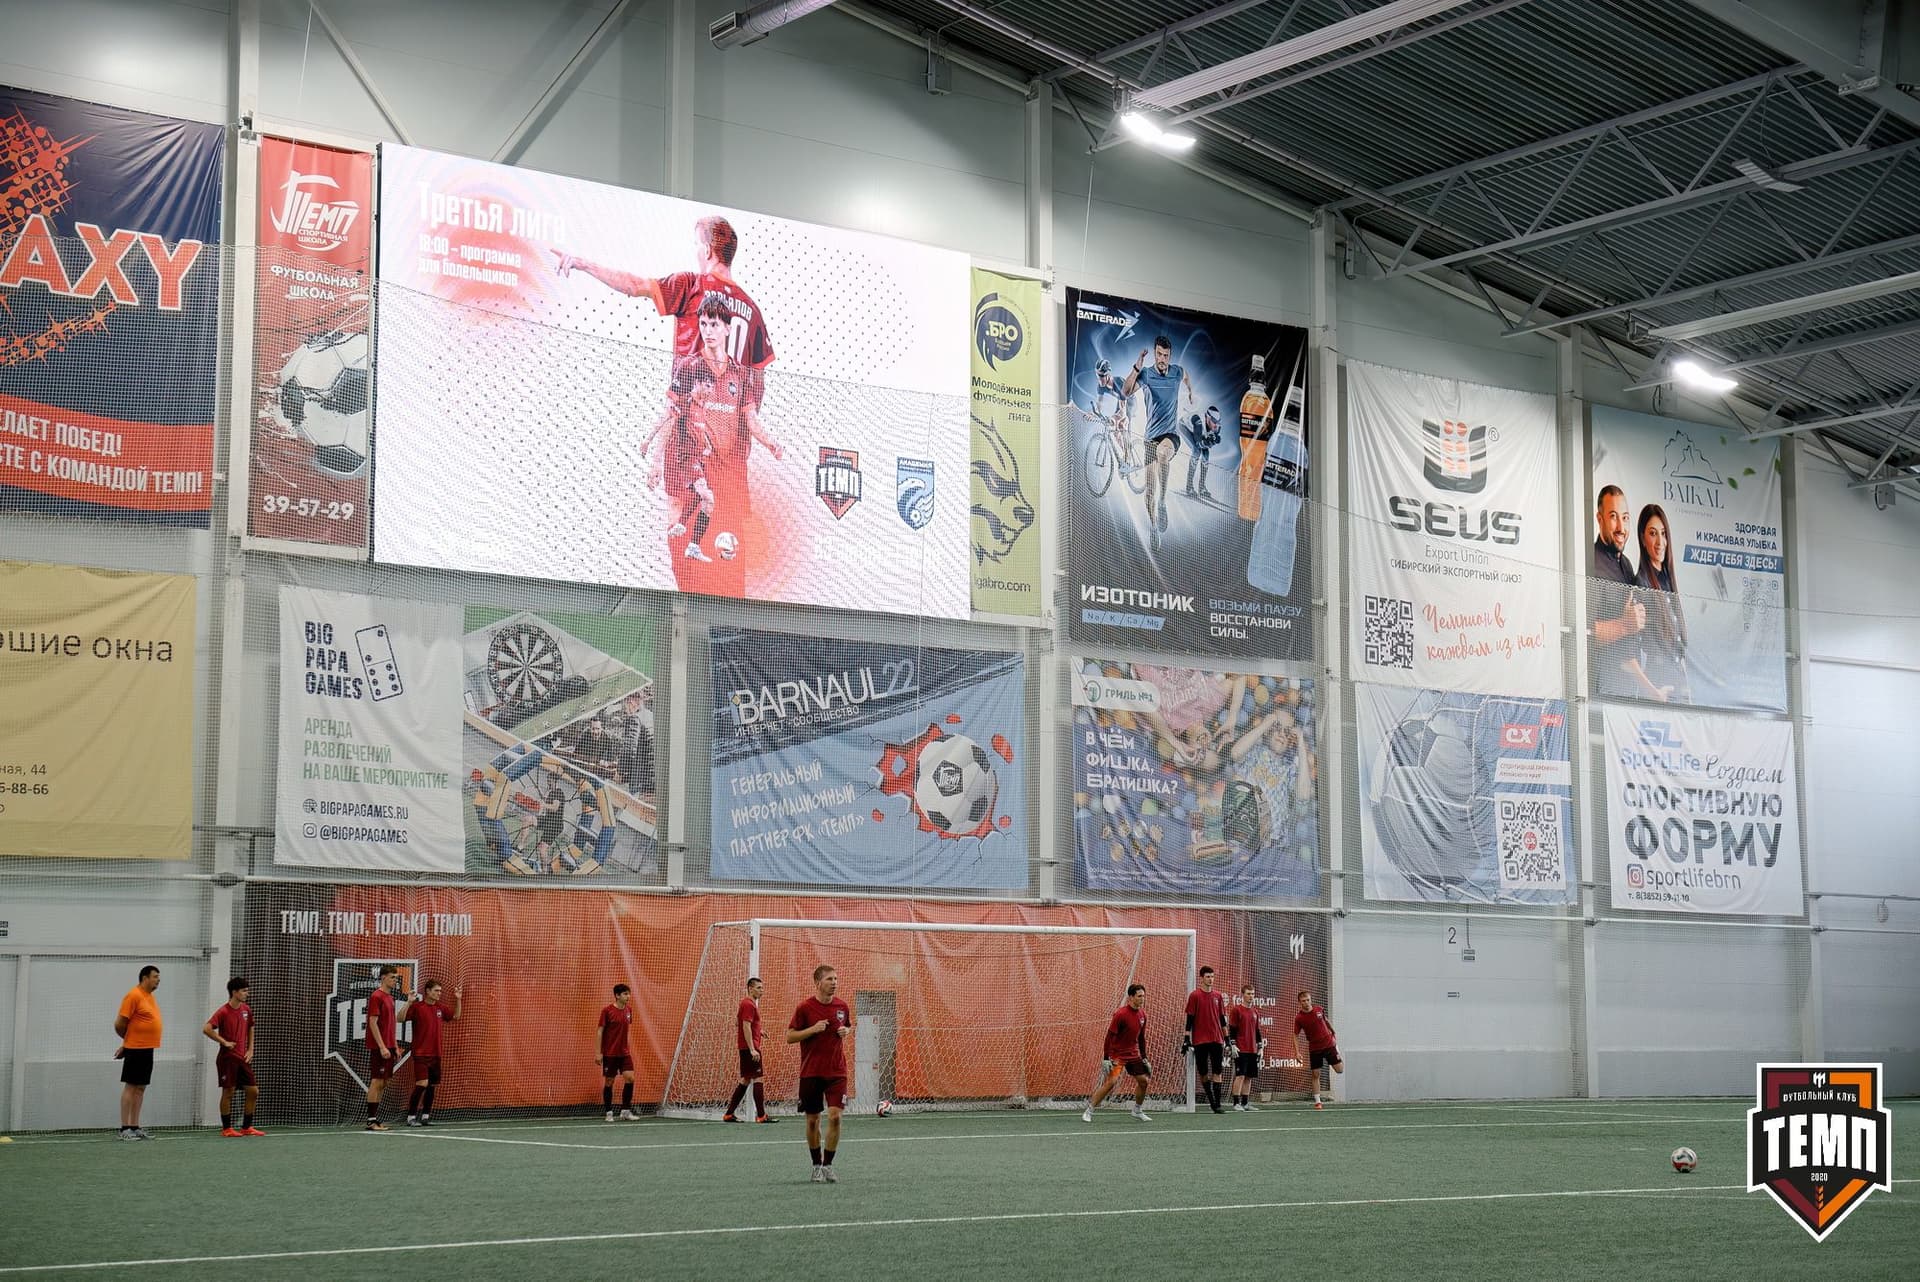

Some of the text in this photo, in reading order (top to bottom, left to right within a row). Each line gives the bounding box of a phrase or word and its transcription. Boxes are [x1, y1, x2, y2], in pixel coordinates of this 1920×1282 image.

[270, 170, 360, 235] ТЕМП
[417, 180, 503, 234] Третья
[460, 244, 521, 268] программа
[271, 265, 358, 288] ФУТБОЛЬНАЯ
[443, 258, 518, 287] болельщиков
[289, 285, 335, 301] ШКОЛА
[1077, 310, 1131, 327] BATTERADE
[972, 376, 1031, 397] Молодёжная
[973, 391, 1031, 409] футбольная
[1008, 412, 1031, 423] лига
[0, 409, 122, 457] ЛАЕТ ПОБЕД!
[0, 443, 202, 493] ТЕ С КОМАНДОЙ ТЕМП!
[819, 467, 859, 498] ТЕМП
[1663, 481, 1725, 509] BAIKAL
[263, 495, 354, 520] 39-57-29
[1389, 496, 1522, 545] SEUS
[1735, 522, 1777, 537] ЗДОРОВАЯ
[1696, 531, 1777, 551] И КРАСИВАЯ УЛЫБКА
[1425, 545, 1489, 566] Export Union
[1690, 548, 1777, 570] ЖДЕТ ТЕБЯ ЗДЕСЬ!
[1391, 558, 1441, 576] СИБИРСКИЙ
[1443, 566, 1499, 581] ЭКСПОРТНЫЙ
[1081, 584, 1195, 613] ИЗОТОНИК
[1209, 599, 1261, 614] ВОЗЬМИ
[1210, 613, 1291, 629] ВОССТАНОВИ
[1423, 603, 1492, 633] Чемпион
[304, 621, 333, 645] BIG
[1210, 627, 1249, 639] СИЛЫ.
[1496, 637, 1512, 660] из
[1517, 623, 1545, 650] нас!
[0, 630, 173, 662] шие окна
[305, 646, 349, 673] PAPA
[305, 671, 363, 700] GAMES
[1105, 689, 1136, 701] ГРИЛЬ
[304, 717, 352, 739] АРЕНДА
[1085, 727, 1135, 749] В ЧЁМ
[304, 739, 392, 763] РАЗВЛЕЧЕНИЙ
[1621, 748, 1700, 772] SportLife
[31, 764, 47, 775] 44
[1086, 752, 1154, 775] ФИШКА,
[1705, 754, 1786, 788] Создаем
[303, 763, 449, 789] НА ВАШЕ МЕРОПРИЯТИЕ
[730, 759, 823, 796] ГЕНЕРАЛЬНЫЙ
[1087, 773, 1178, 794] БРАТИШКА?
[320, 801, 409, 820] BIGPAPAGAMES.RU
[731, 783, 856, 828] ИНФОРМАЦИОННЫЙ
[1623, 782, 1782, 818] СПОРТИВНУЮ
[320, 824, 408, 844] @BIGPAPAGAMES
[730, 813, 865, 858] ПАРТНЕР ФК «ТЕМП»
[1625, 815, 1782, 867] ФОРМУ
[1646, 867, 1741, 890] sportlifebrn
[281, 910, 473, 937] ТЕМП, ТЕМП, ТОЛЬКО ТЕМП!
[1448, 926, 1457, 944] 2
